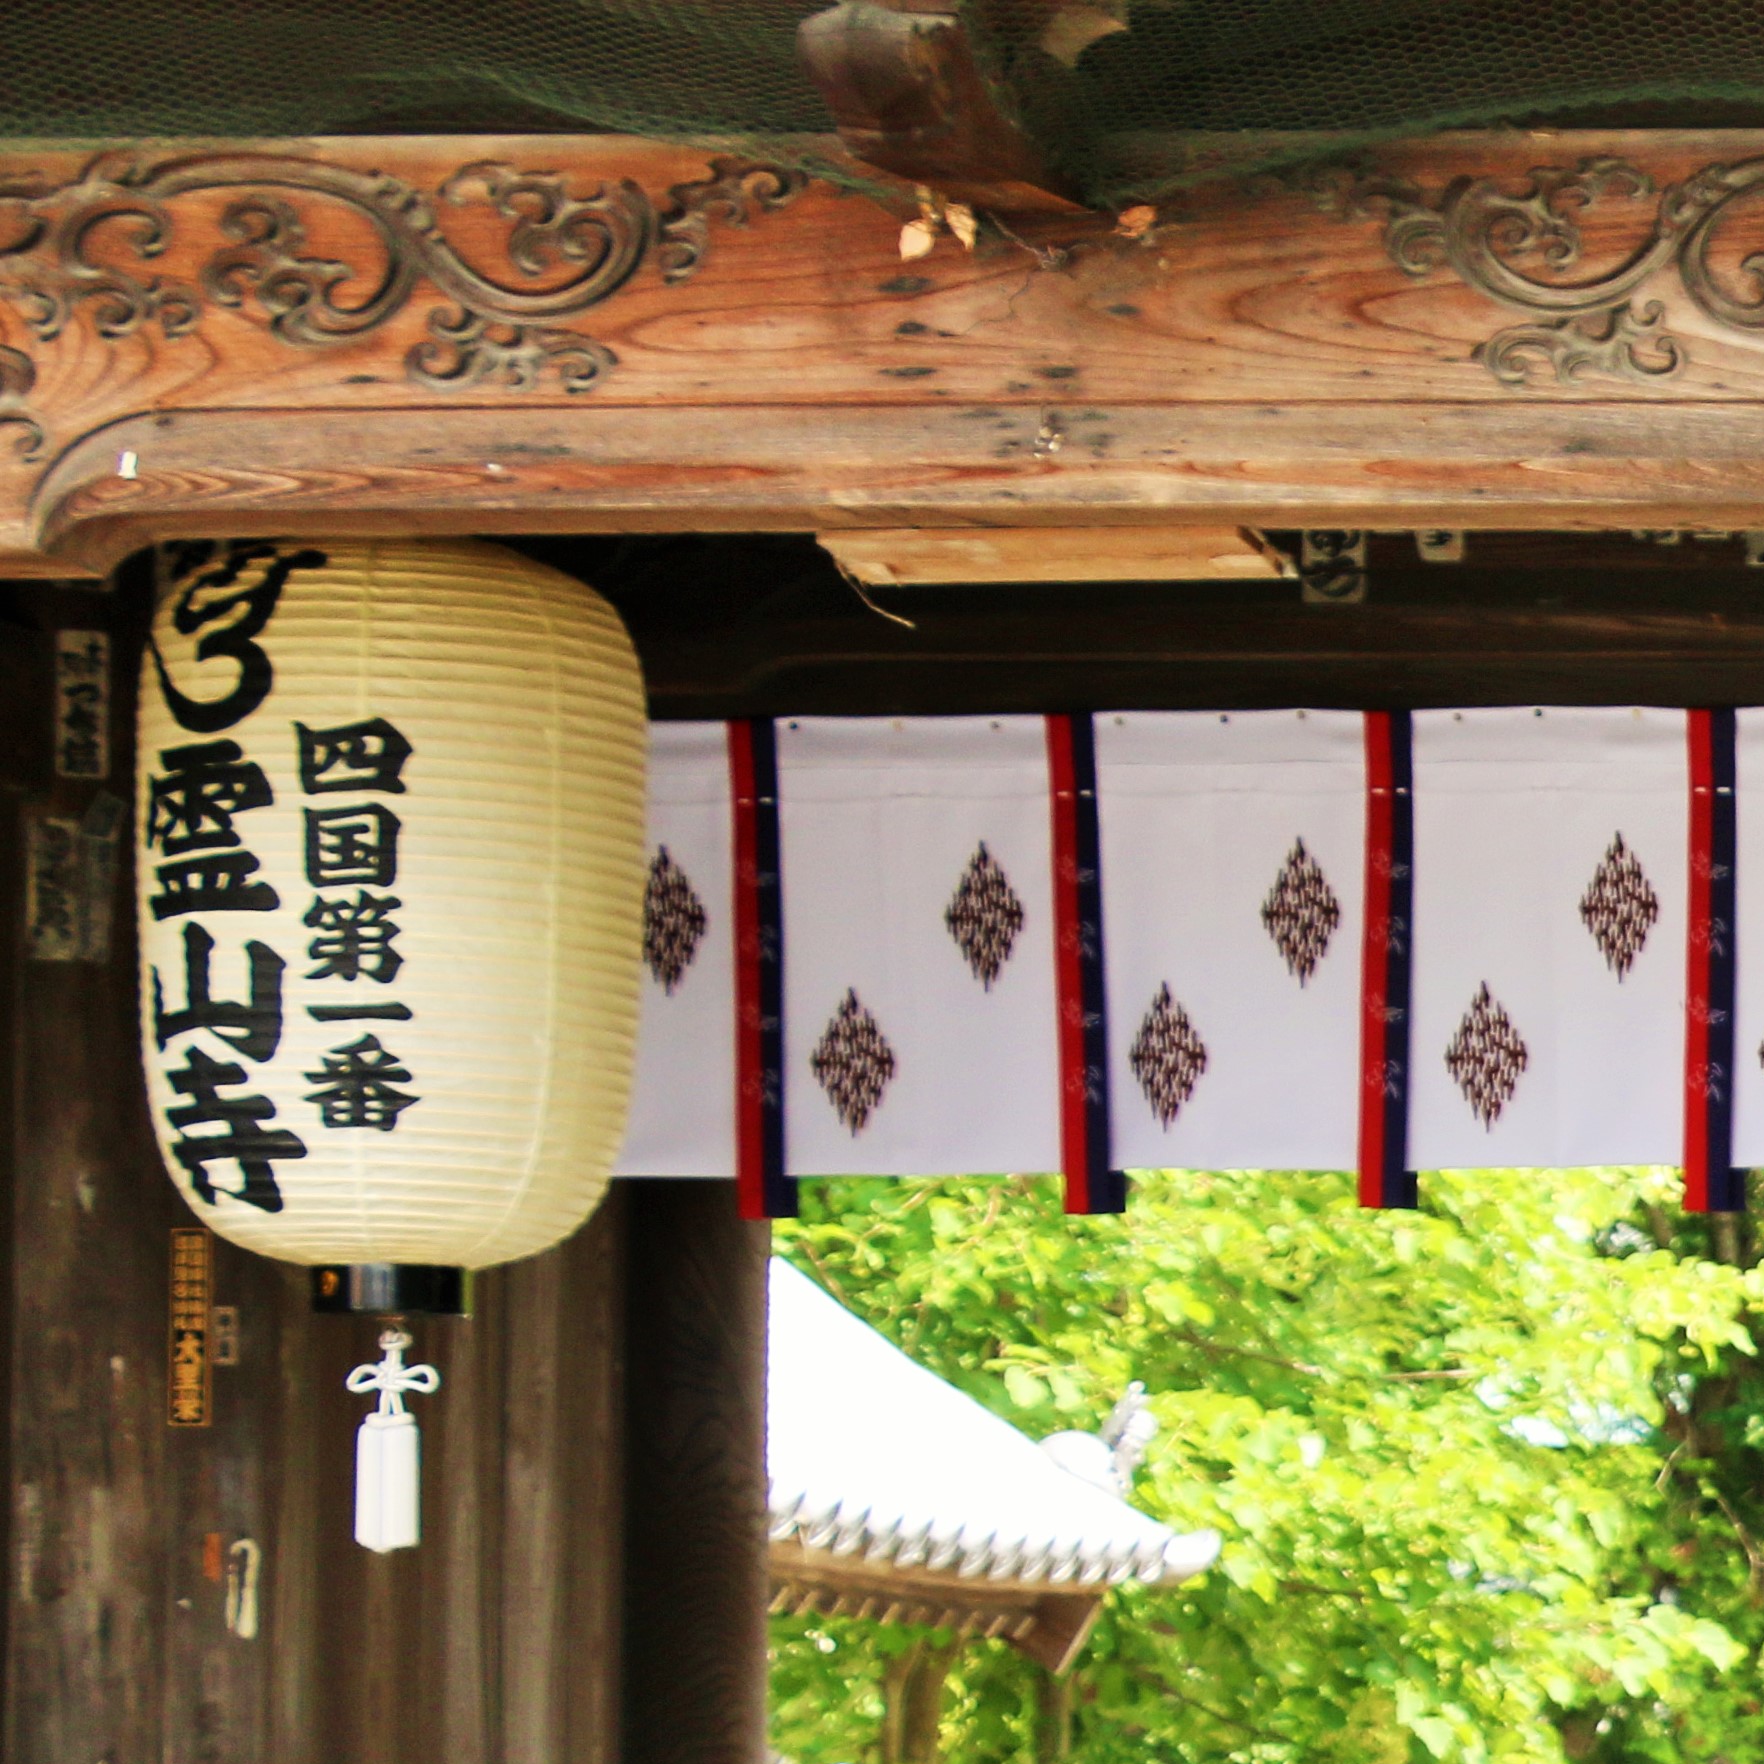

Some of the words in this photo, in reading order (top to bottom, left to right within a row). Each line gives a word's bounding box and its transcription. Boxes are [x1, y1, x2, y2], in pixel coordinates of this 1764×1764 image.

[147, 738, 308, 1214] 霊山寺
[294, 717, 422, 1132] 四国第一番
